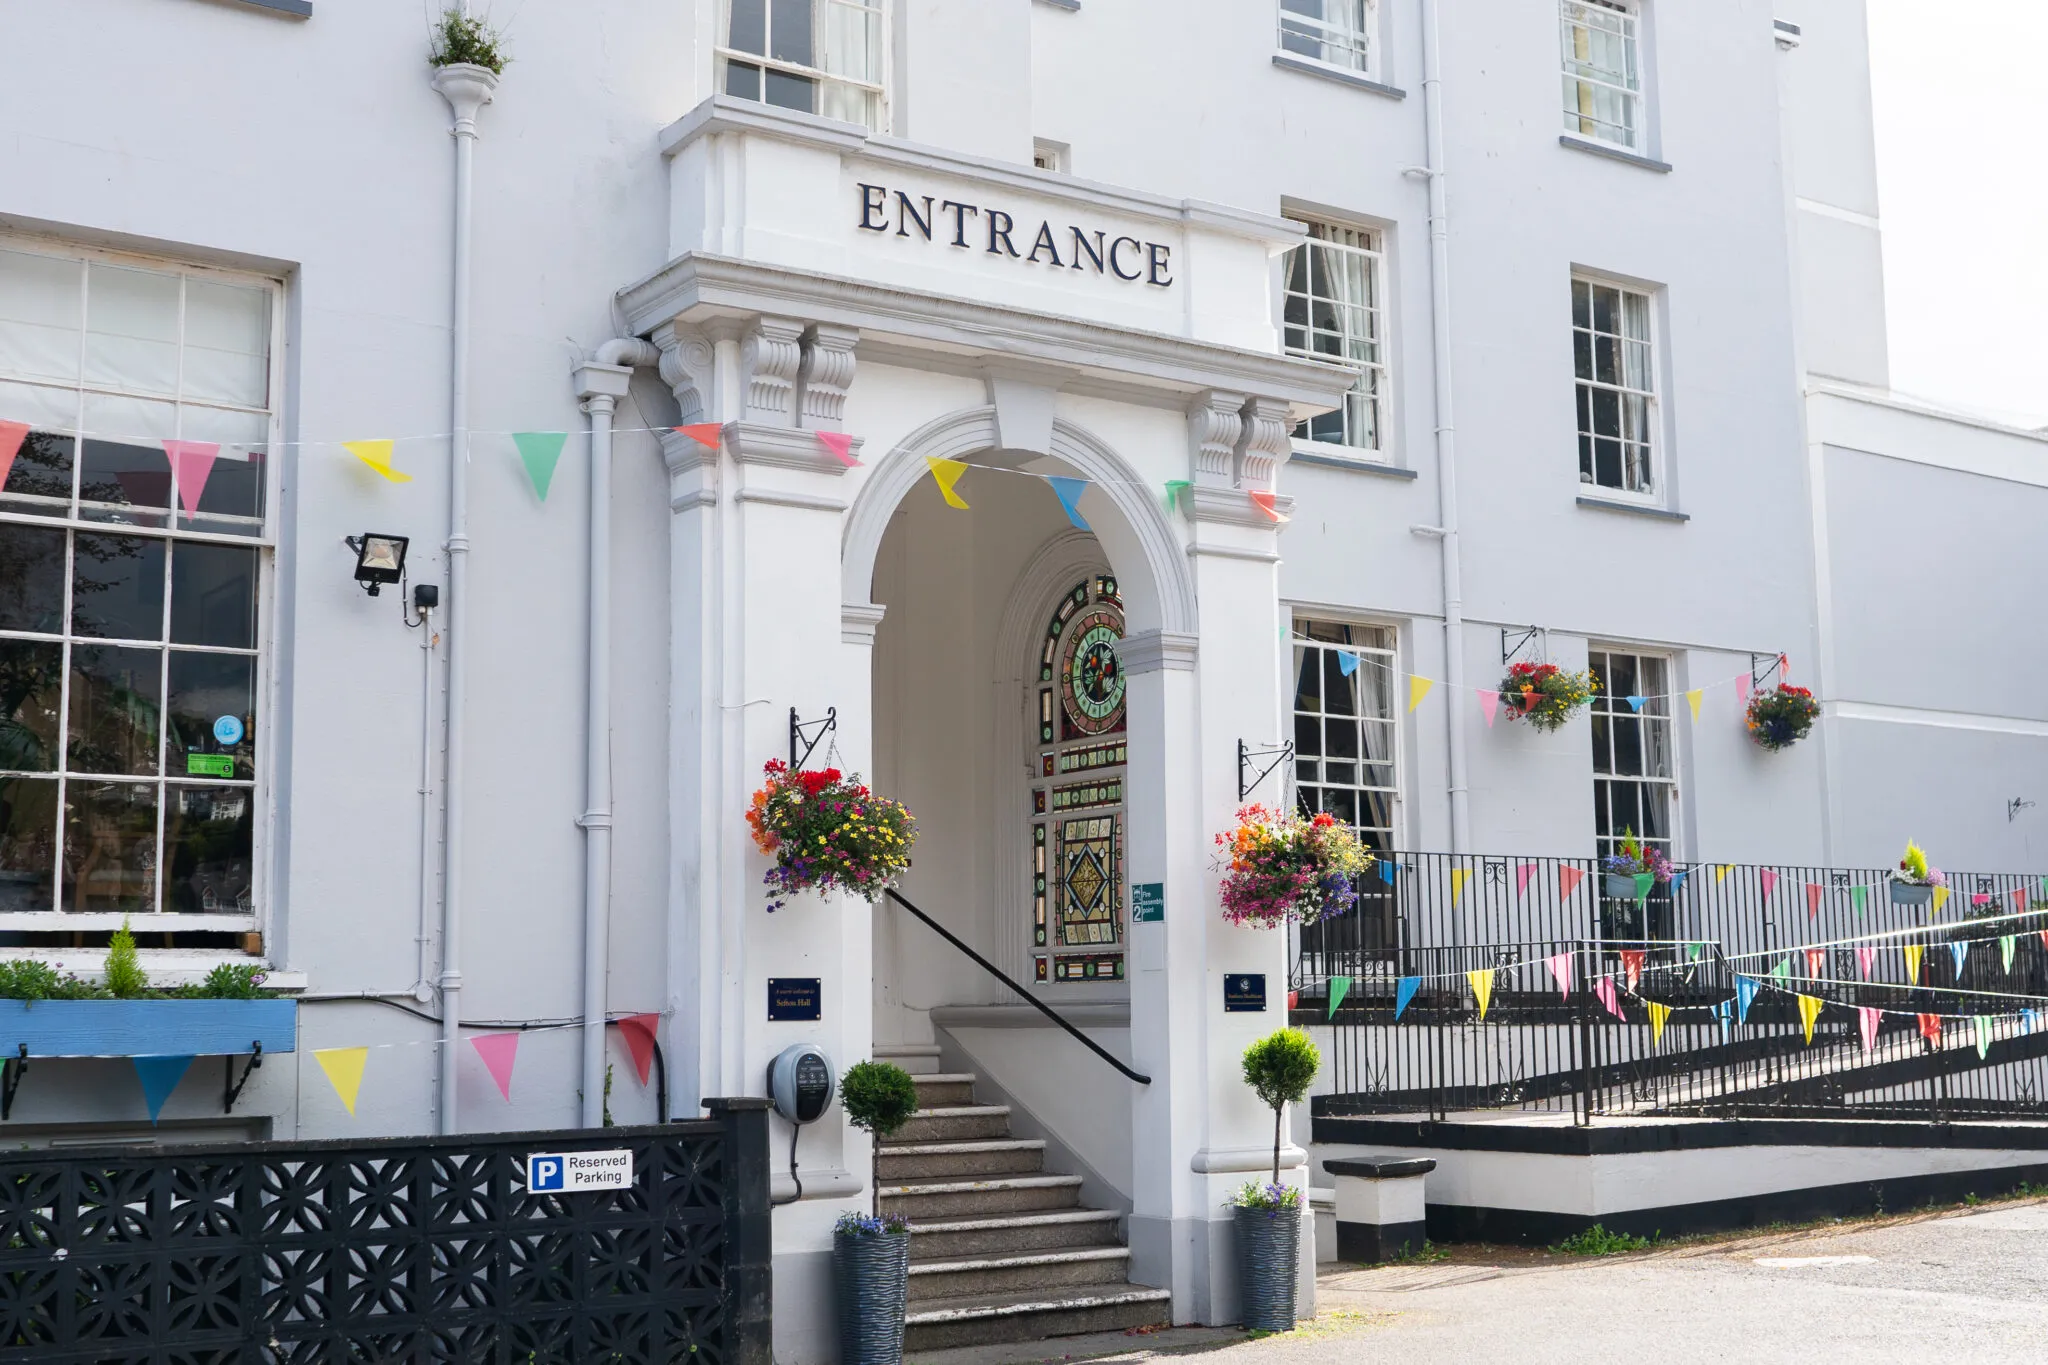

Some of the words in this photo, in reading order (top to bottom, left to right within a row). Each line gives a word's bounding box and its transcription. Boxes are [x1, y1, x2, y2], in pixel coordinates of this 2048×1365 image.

[856, 182, 1173, 287] ENTRANCE
[1133, 905, 1141, 922] 2
[797, 998, 811, 1006] Hall
[569, 1154, 627, 1168] Reserved
[538, 1161, 557, 1187] P
[575, 1170, 622, 1184] Parking
